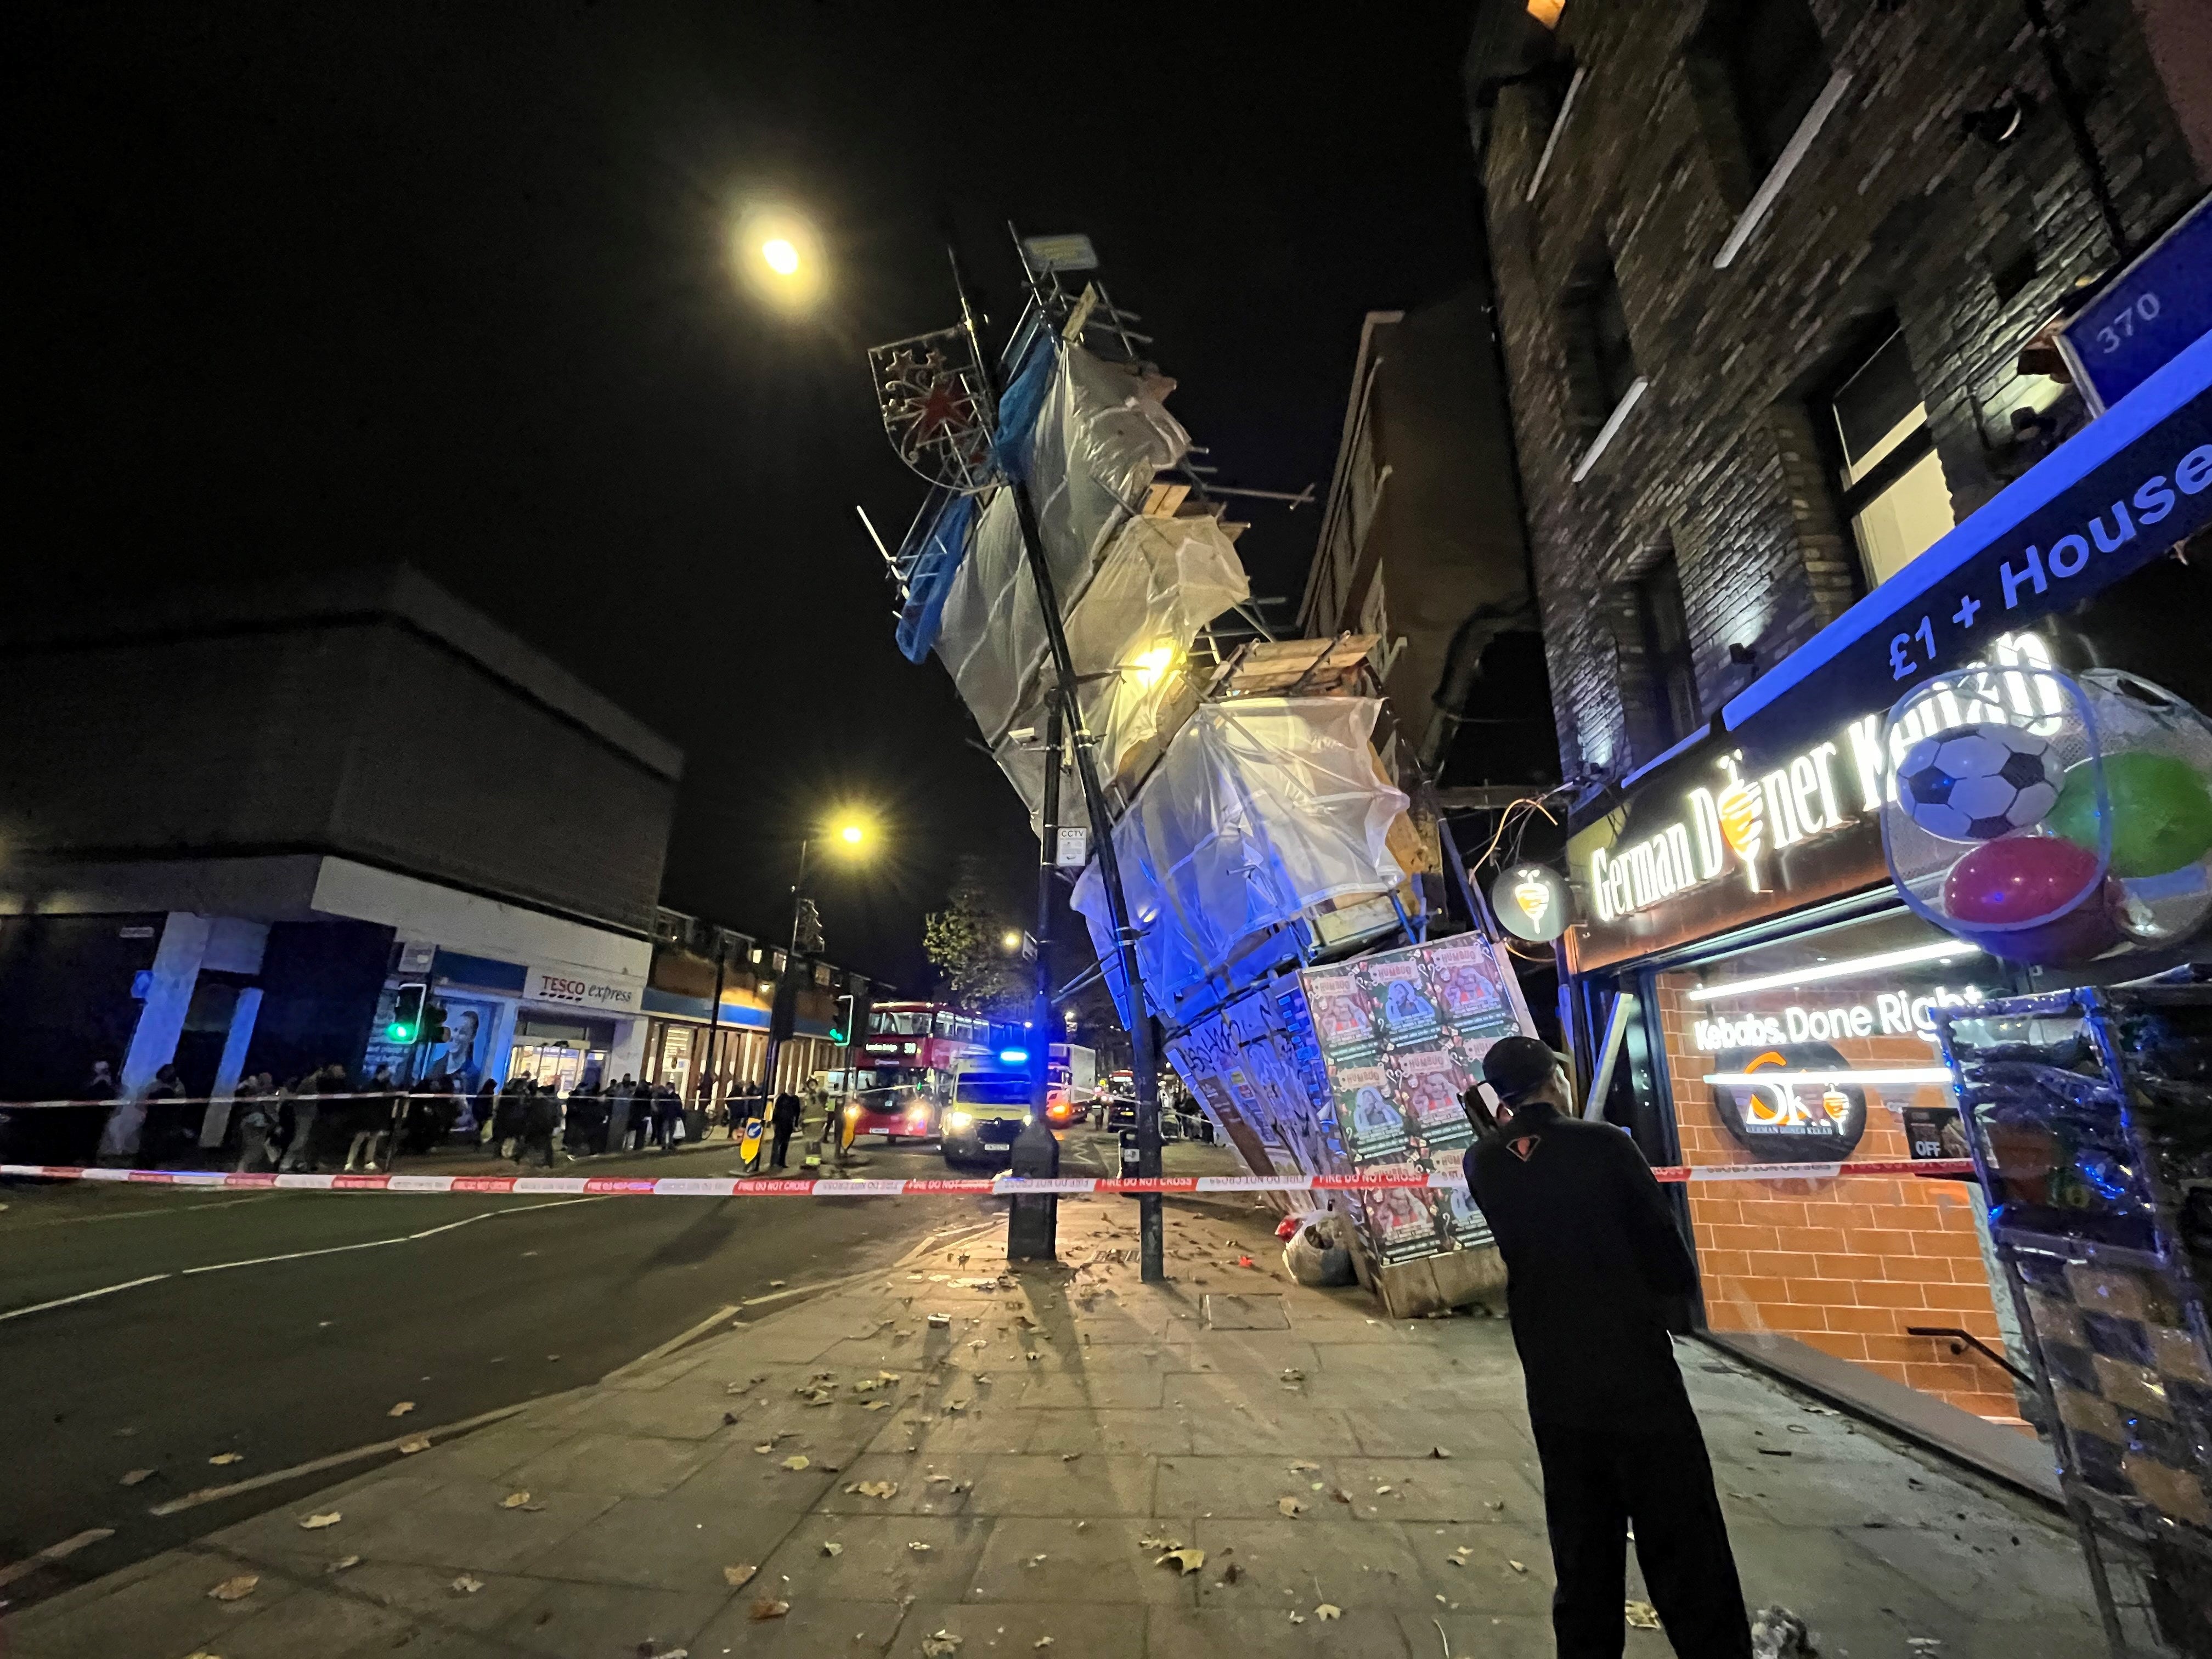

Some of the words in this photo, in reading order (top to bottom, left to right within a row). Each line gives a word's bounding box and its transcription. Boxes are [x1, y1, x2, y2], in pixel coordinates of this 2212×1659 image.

[2096, 292, 2160, 354] 370
[1889, 615, 1937, 681] £1
[1590, 821, 1697, 923] German
[541, 975, 586, 995] TESCO
[588, 984, 633, 1003] express
[1785, 1005, 1873, 1043] Done
[1915, 1141, 1940, 1156] OFF
[1101, 1178, 1122, 1187] FIRE
[1123, 1178, 1137, 1187] DO
[1138, 1178, 1157, 1187] NOT
[1160, 1177, 1192, 1186] CROSS
[1344, 1175, 1359, 1183] DO
[1362, 1173, 1382, 1183] NOT
